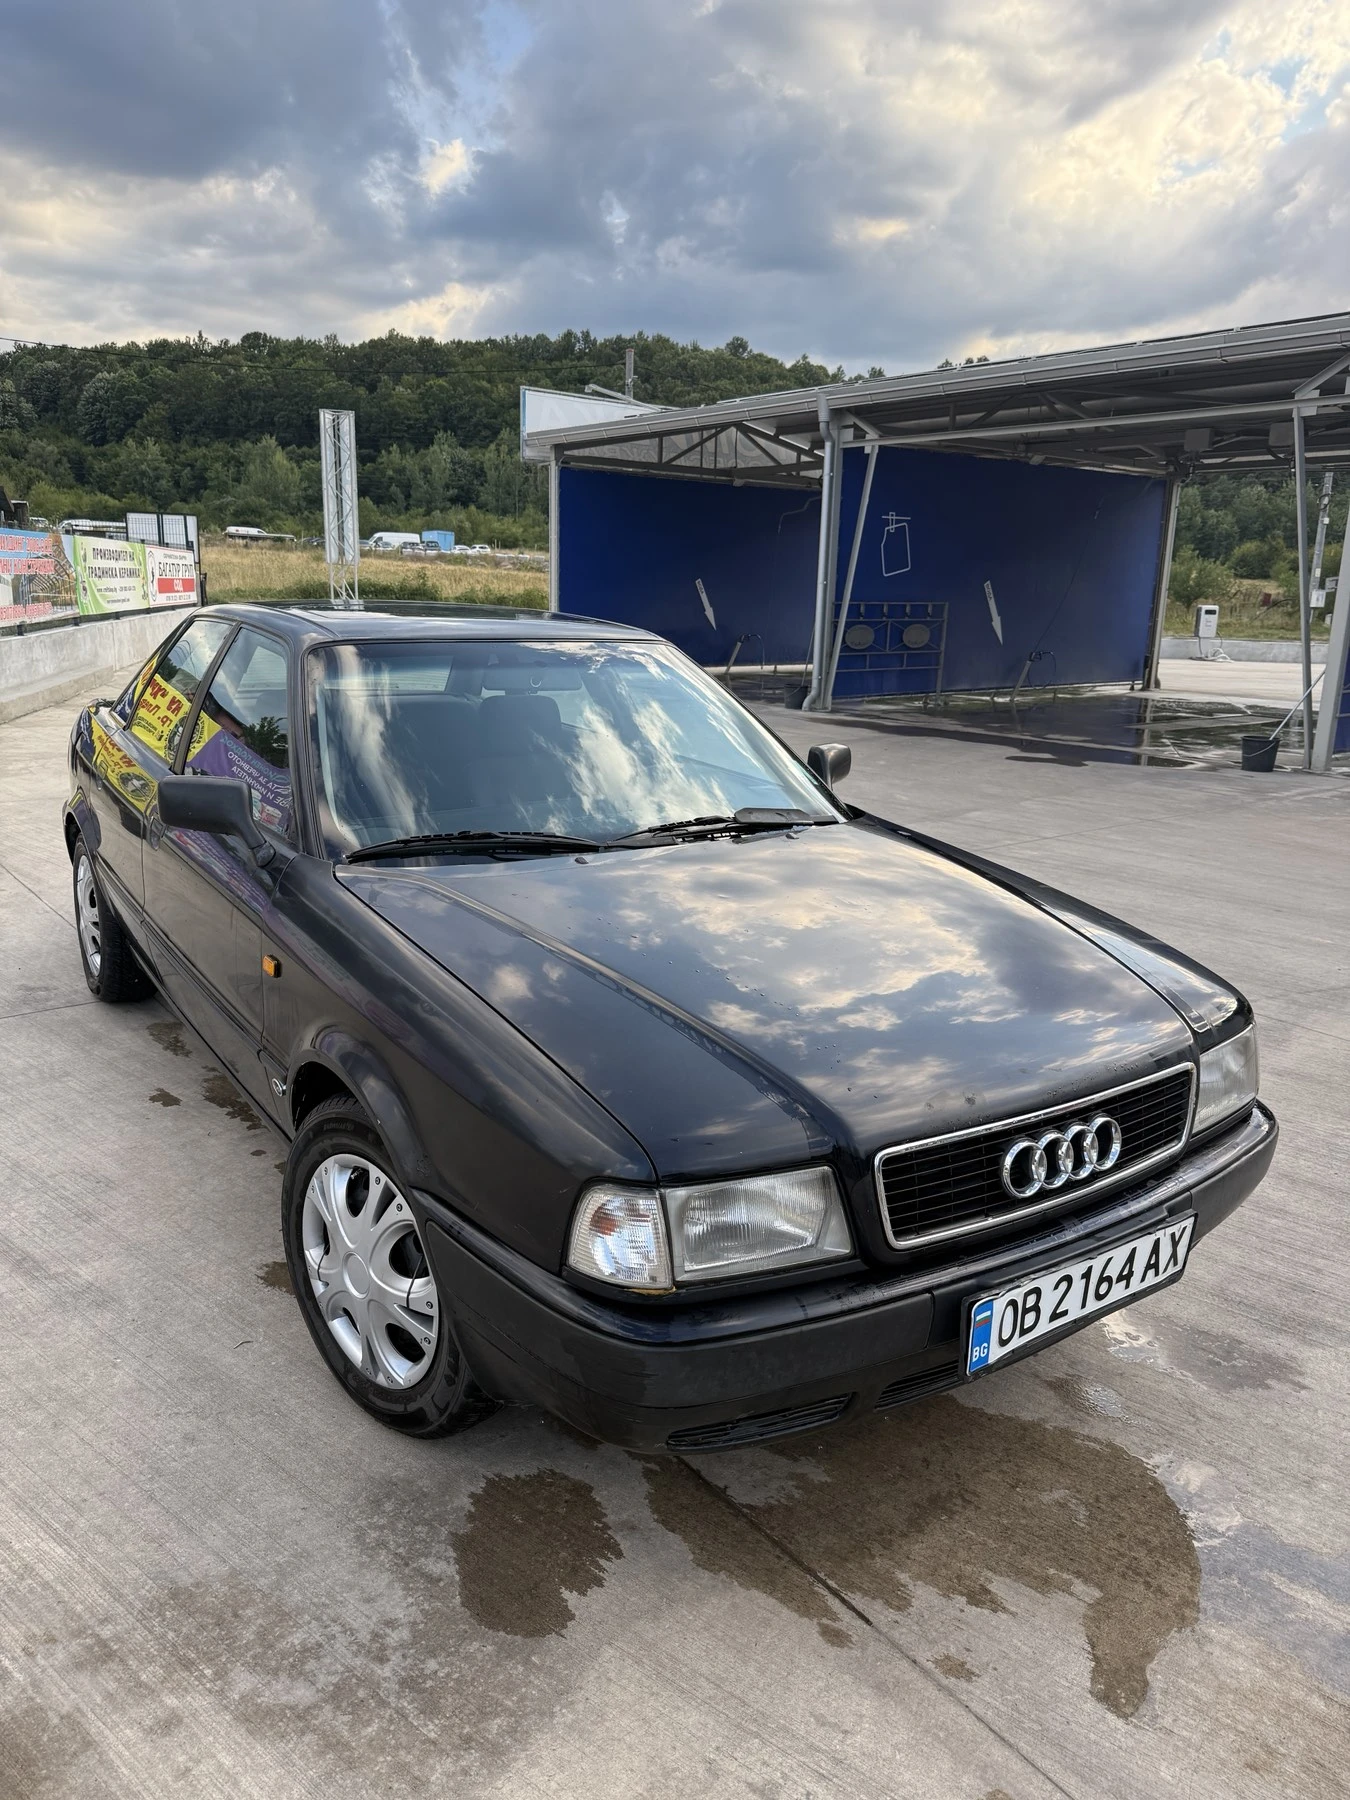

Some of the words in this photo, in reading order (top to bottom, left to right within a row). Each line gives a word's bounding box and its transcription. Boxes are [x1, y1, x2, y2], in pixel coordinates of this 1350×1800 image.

[88, 566, 118, 581] ГРАДИНСКА
[119, 567, 141, 579] КЕРАМИКА
[158, 561, 181, 577] БАГАТУР
[972, 1341, 988, 1362] BG
